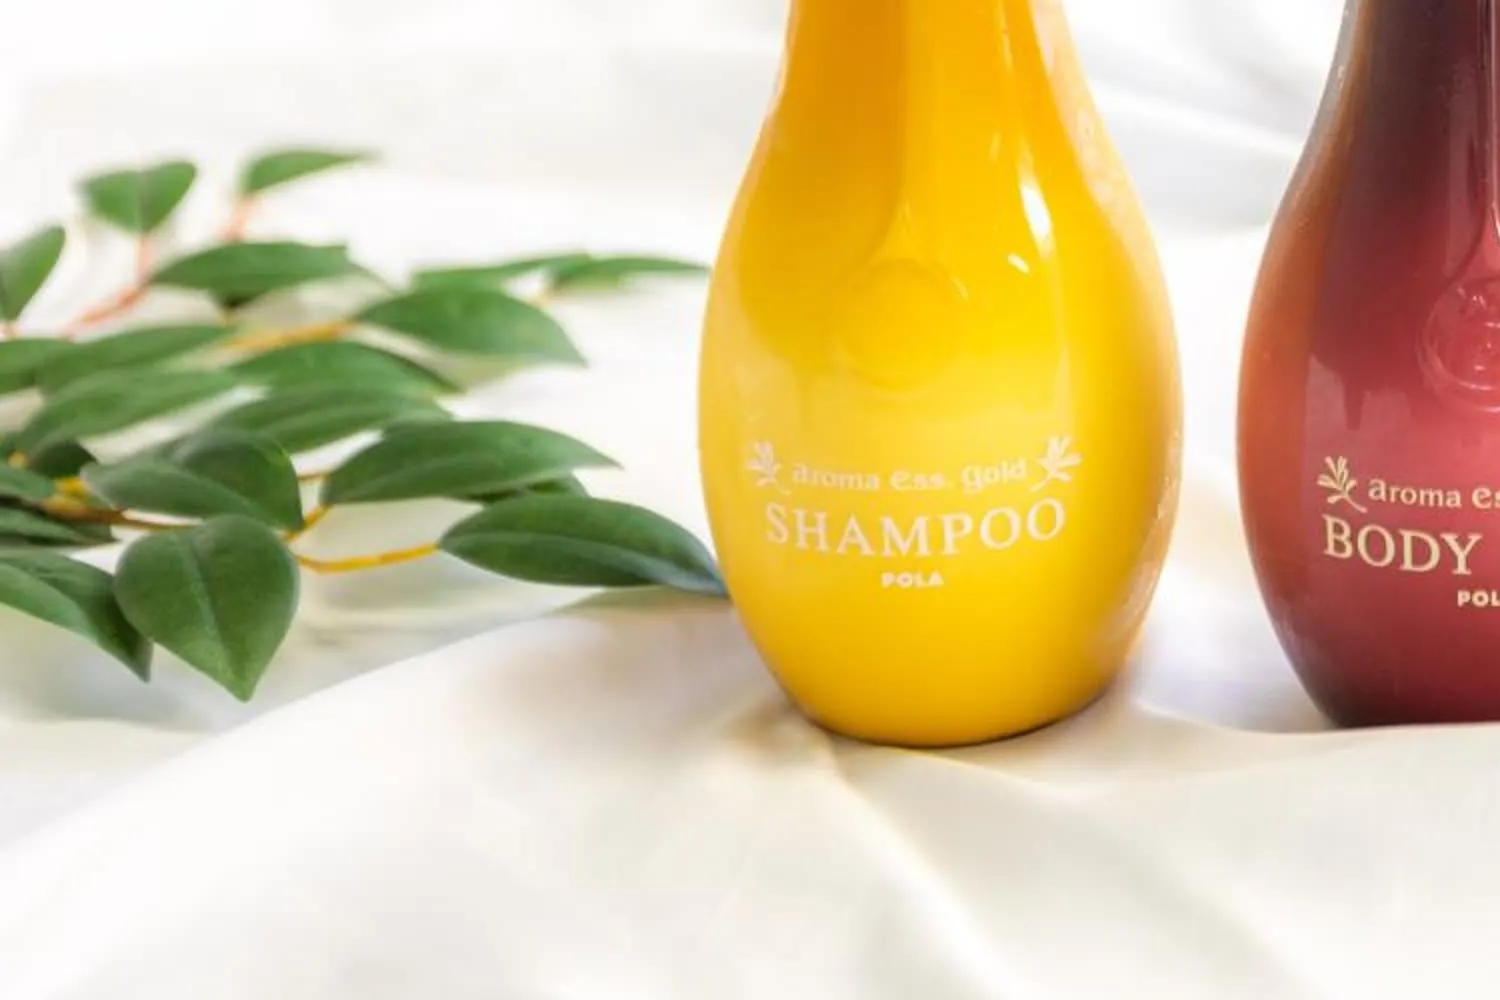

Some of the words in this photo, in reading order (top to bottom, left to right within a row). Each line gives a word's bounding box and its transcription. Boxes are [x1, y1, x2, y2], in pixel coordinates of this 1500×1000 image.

[792, 462, 880, 491] aroma
[961, 459, 1027, 494] gold
[1368, 478, 1462, 509] aroma
[765, 497, 1067, 558] SHAMPOO
[1322, 513, 1483, 576] BODY
[880, 570, 945, 589] POLA
